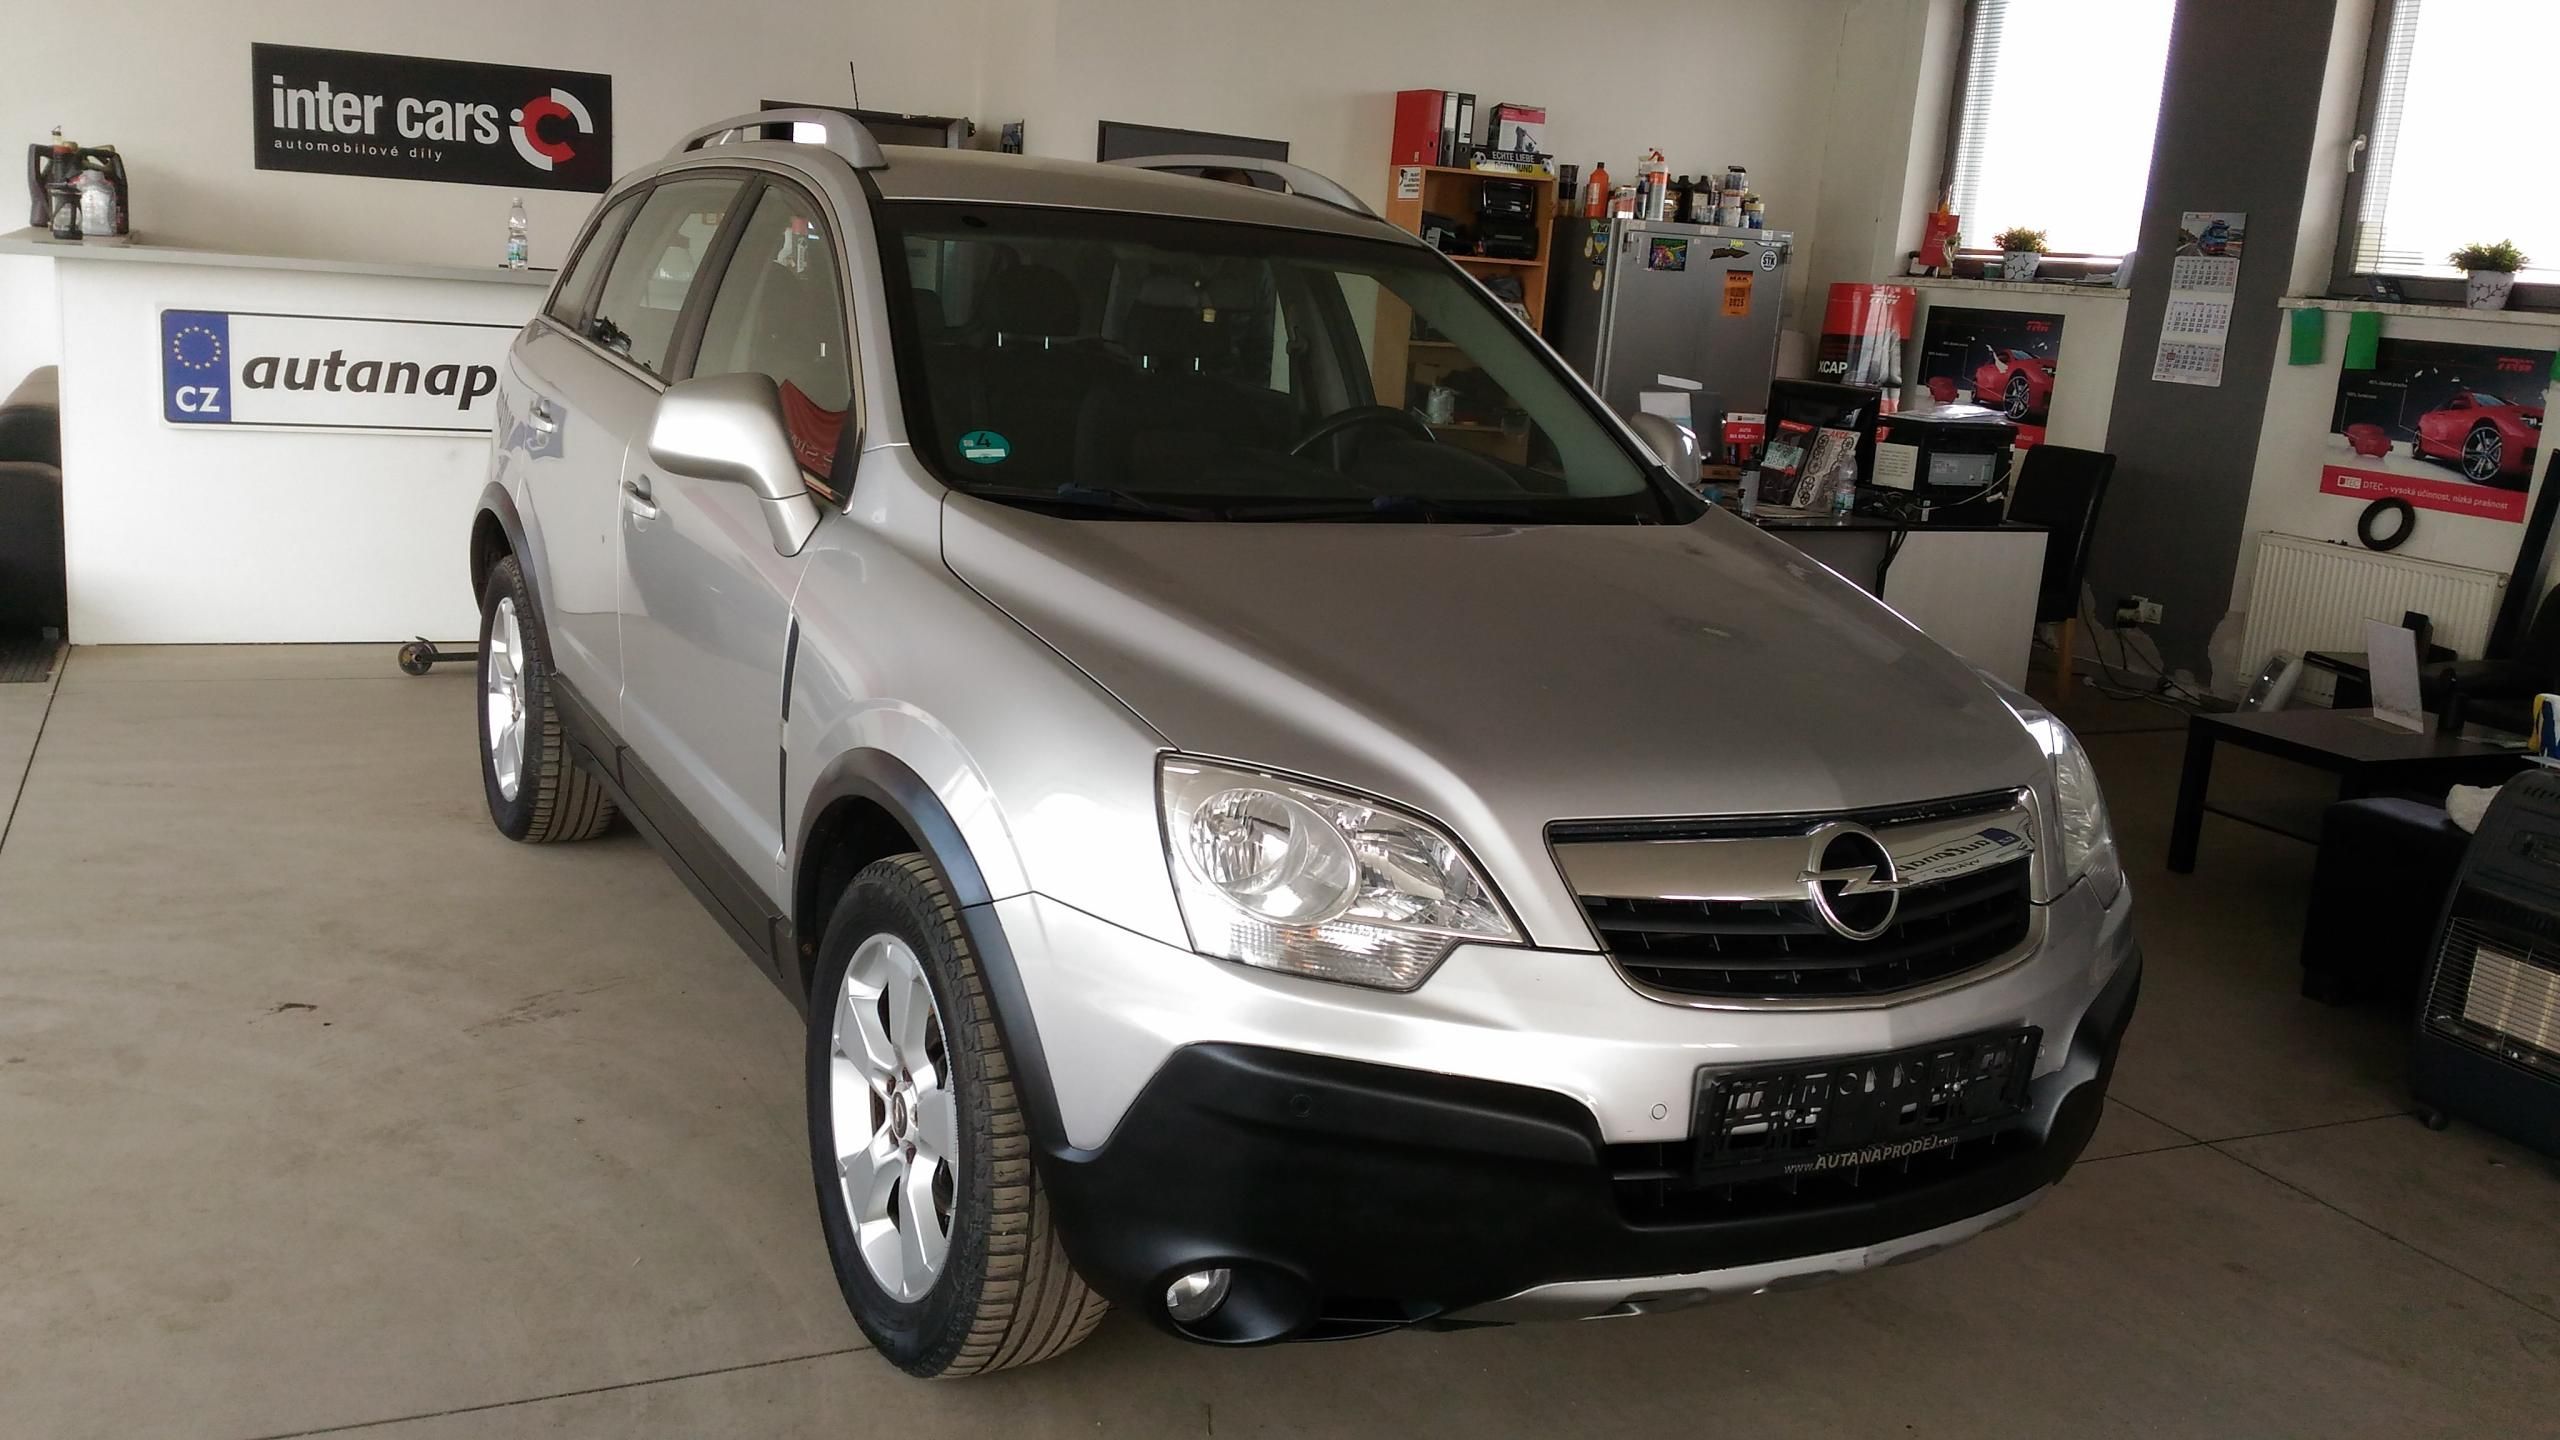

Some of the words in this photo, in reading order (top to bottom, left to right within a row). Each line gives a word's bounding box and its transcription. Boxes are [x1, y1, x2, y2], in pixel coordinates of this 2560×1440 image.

[272, 75, 383, 135] inter
[397, 97, 499, 144] cars
[274, 139, 399, 158] automobilové
[409, 146, 443, 163] díly
[1492, 151, 1515, 161] ECHTE
[1516, 153, 1535, 163] LIEBE
[1762, 256, 1775, 265] STK
[176, 385, 220, 414] CZ
[976, 432, 992, 447] 4
[2362, 480, 2384, 491] DTEC
